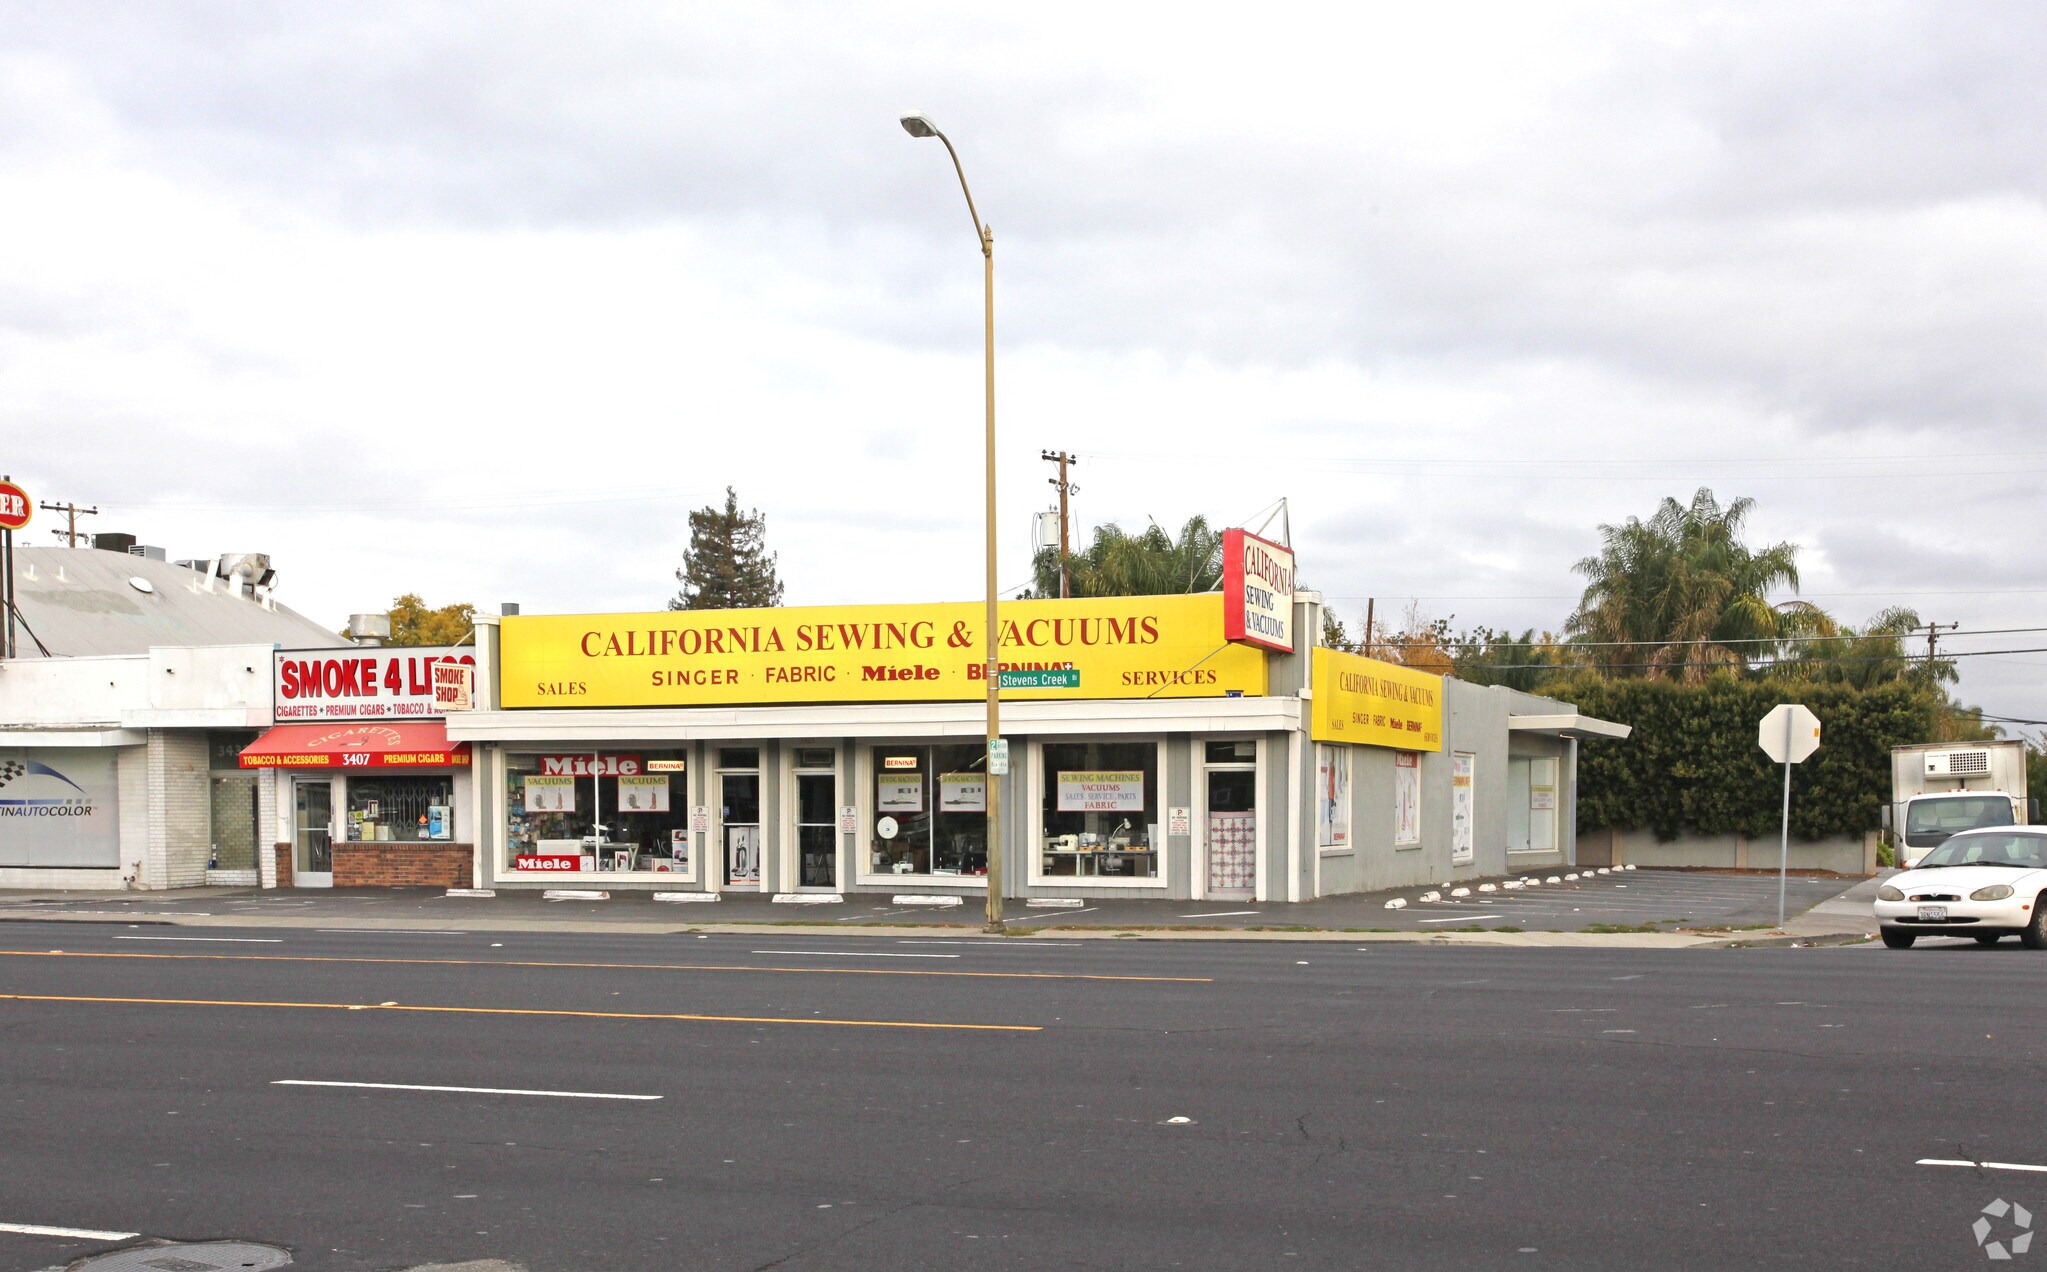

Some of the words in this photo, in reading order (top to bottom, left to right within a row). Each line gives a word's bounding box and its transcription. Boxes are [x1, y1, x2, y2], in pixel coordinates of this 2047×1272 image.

[1244, 545, 1292, 596] CALIFORNIA
[1246, 585, 1274, 611] SEWING
[1246, 610, 1252, 630] &
[1252, 612, 1284, 639] VACUUMS
[581, 626, 786, 657] CALIFORNIA
[797, 621, 935, 652] SEWING
[947, 620, 973, 648] &
[281, 659, 377, 699] SMOKE
[384, 658, 402, 696] 4
[435, 667, 464, 684] SMOKE
[652, 669, 739, 686] SINGER
[766, 666, 836, 683] FABRIC
[861, 665, 940, 681] Miele
[1002, 675, 1038, 686] Stevens
[1041, 674, 1068, 685] Creek
[1122, 670, 1217, 686] SERVICES
[435, 686, 459, 702] SHOP
[537, 682, 587, 696] SALES
[1339, 671, 1378, 696] CALIFORNIA
[1380, 680, 1403, 702] SEWING
[1403, 684, 1409, 702] &
[1410, 686, 1434, 707] VACUUMS
[276, 705, 318, 717] CIGARETTES
[325, 704, 357, 716] PREMIUM
[359, 704, 385, 716] CIGARS
[393, 703, 424, 715] TOBACCO
[427, 703, 432, 714] &
[1352, 712, 1369, 725] SINGER
[1373, 714, 1386, 727] FABRIC
[1390, 717, 1403, 730] Miele
[307, 727, 401, 747] CIGARETTES
[991, 741, 996, 750] 2
[243, 756, 275, 765] TOBACCO
[276, 756, 282, 764] &
[283, 755, 329, 765] ACCESSORIES
[342, 753, 370, 766] 3407
[383, 754, 416, 764] PREMIUM
[417, 753, 444, 763] CIGARS
[543, 756, 638, 775] Miele
[527, 777, 572, 785] VACUUMS
[621, 777, 666, 785] VACUUMS
[1061, 774, 1094, 782] SEWING
[1096, 774, 1140, 782] MACHINES
[518, 858, 571, 870] Miele
